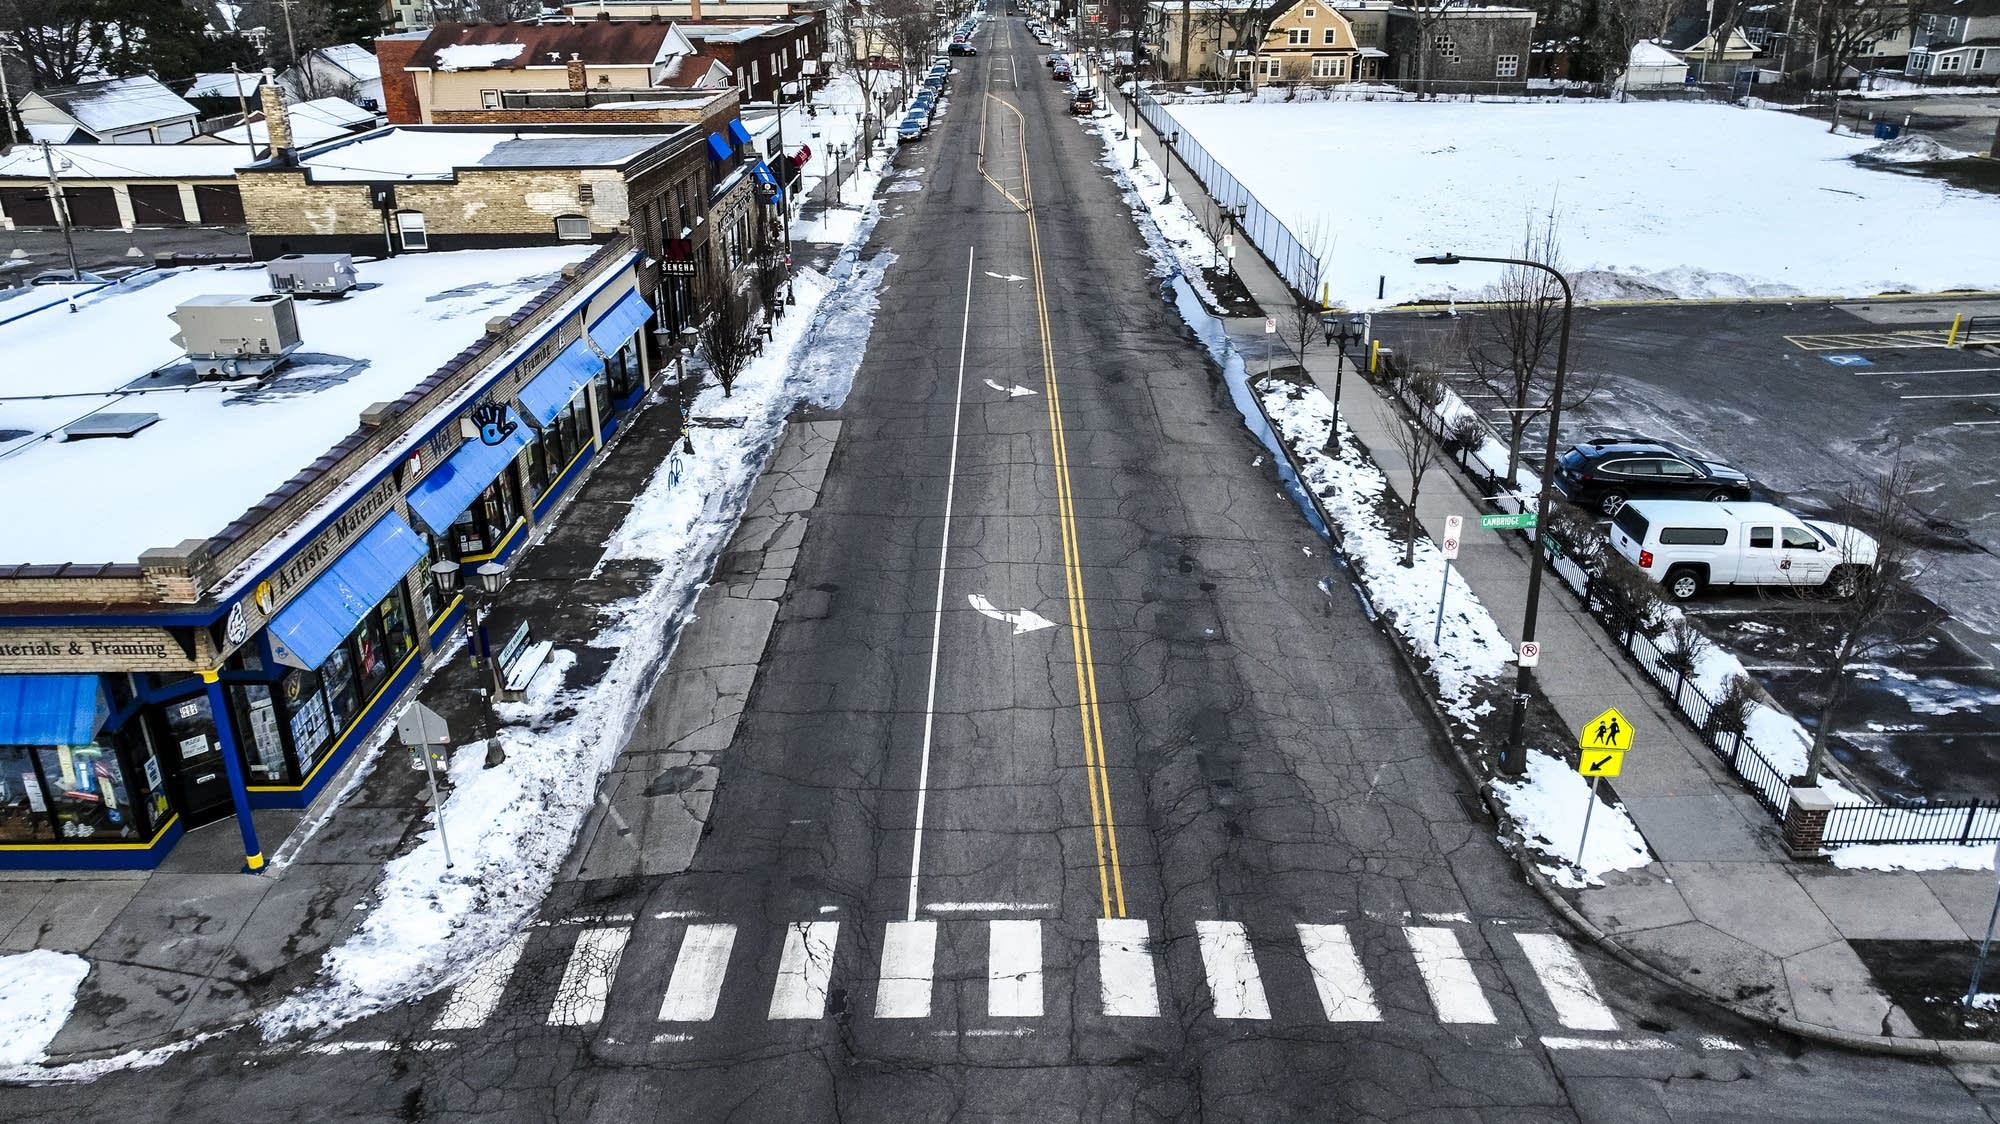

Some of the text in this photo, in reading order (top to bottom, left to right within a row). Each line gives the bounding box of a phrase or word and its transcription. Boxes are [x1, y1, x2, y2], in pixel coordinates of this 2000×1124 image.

[334, 481, 394, 543] Materials
[1482, 516, 1520, 527] CAMBRIDGE
[69, 640, 84, 656] &
[92, 640, 167, 658] Framing
